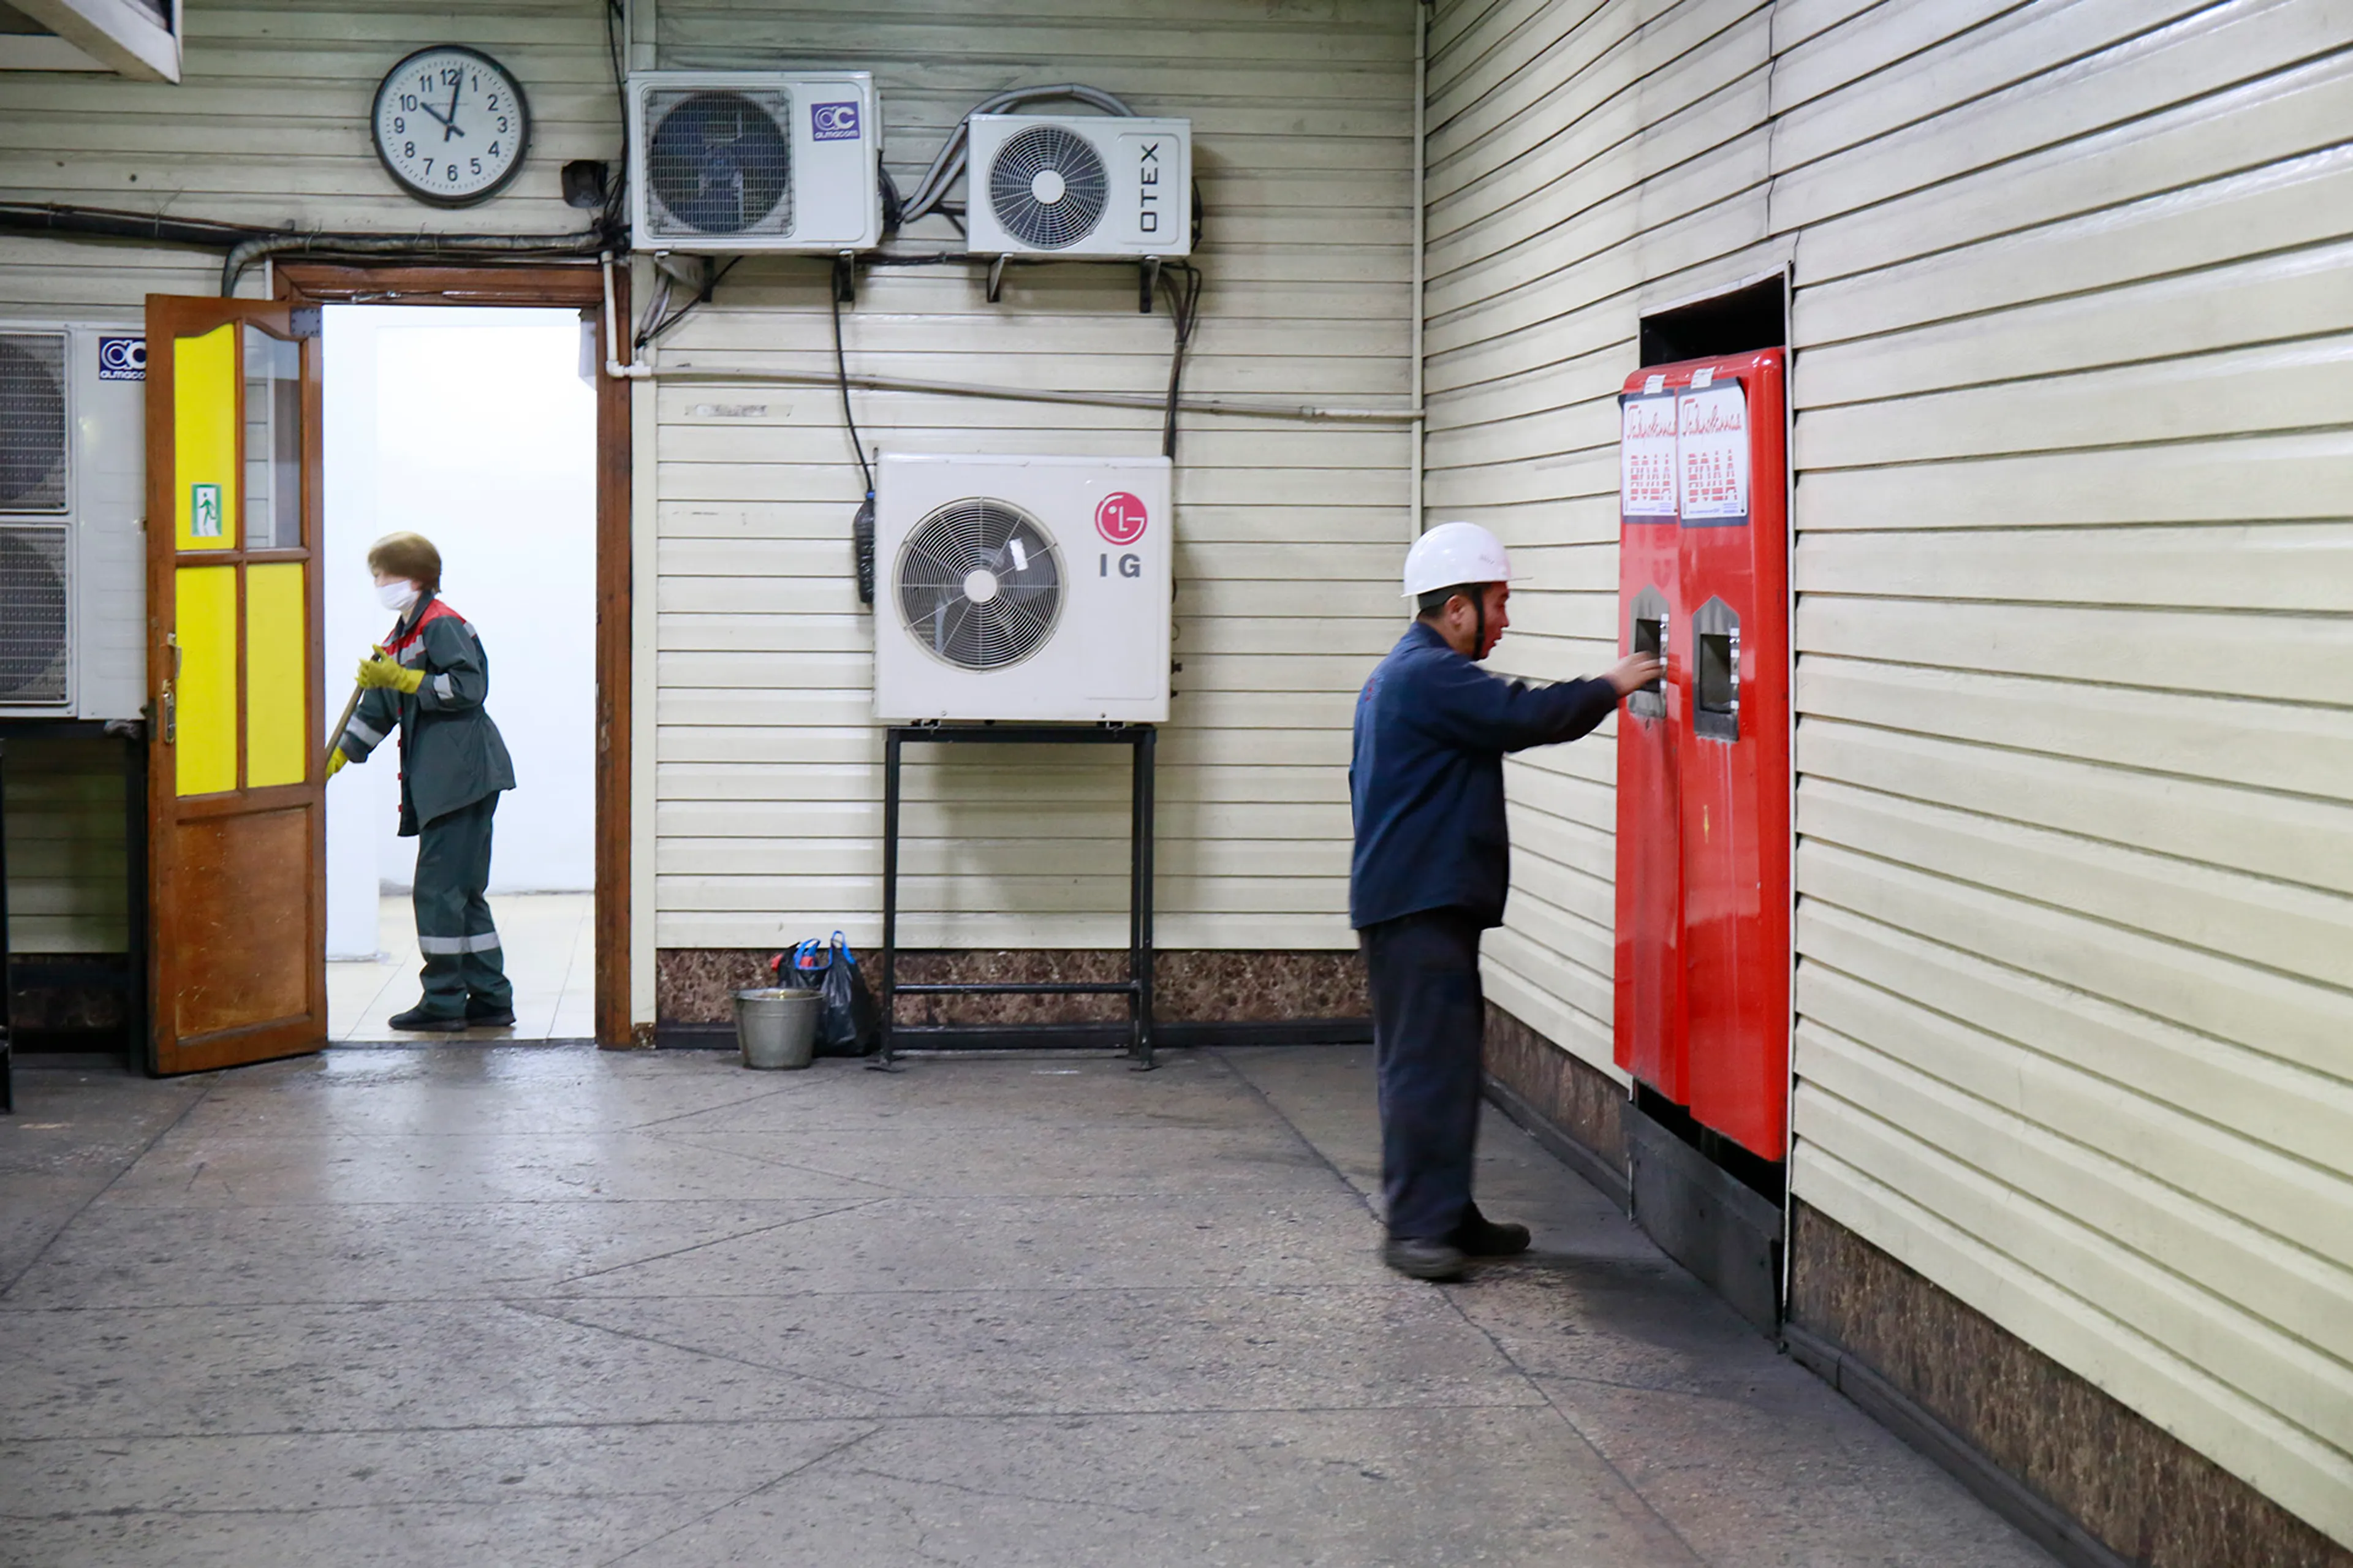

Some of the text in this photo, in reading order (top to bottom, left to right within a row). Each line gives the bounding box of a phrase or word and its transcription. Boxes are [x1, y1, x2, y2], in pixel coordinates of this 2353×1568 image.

[419, 75, 433, 92] 11
[440, 69, 460, 86] 12
[471, 75, 478, 92] 1
[399, 94, 418, 112] 10
[487, 94, 498, 111] 2
[394, 116, 404, 134] 9
[497, 116, 507, 133] 3
[404, 141, 415, 158] 8
[488, 140, 500, 158] 4
[423, 158, 434, 175] 7
[447, 164, 458, 181] 6
[470, 157, 481, 175] 5
[1140, 142, 1159, 232] OTEX
